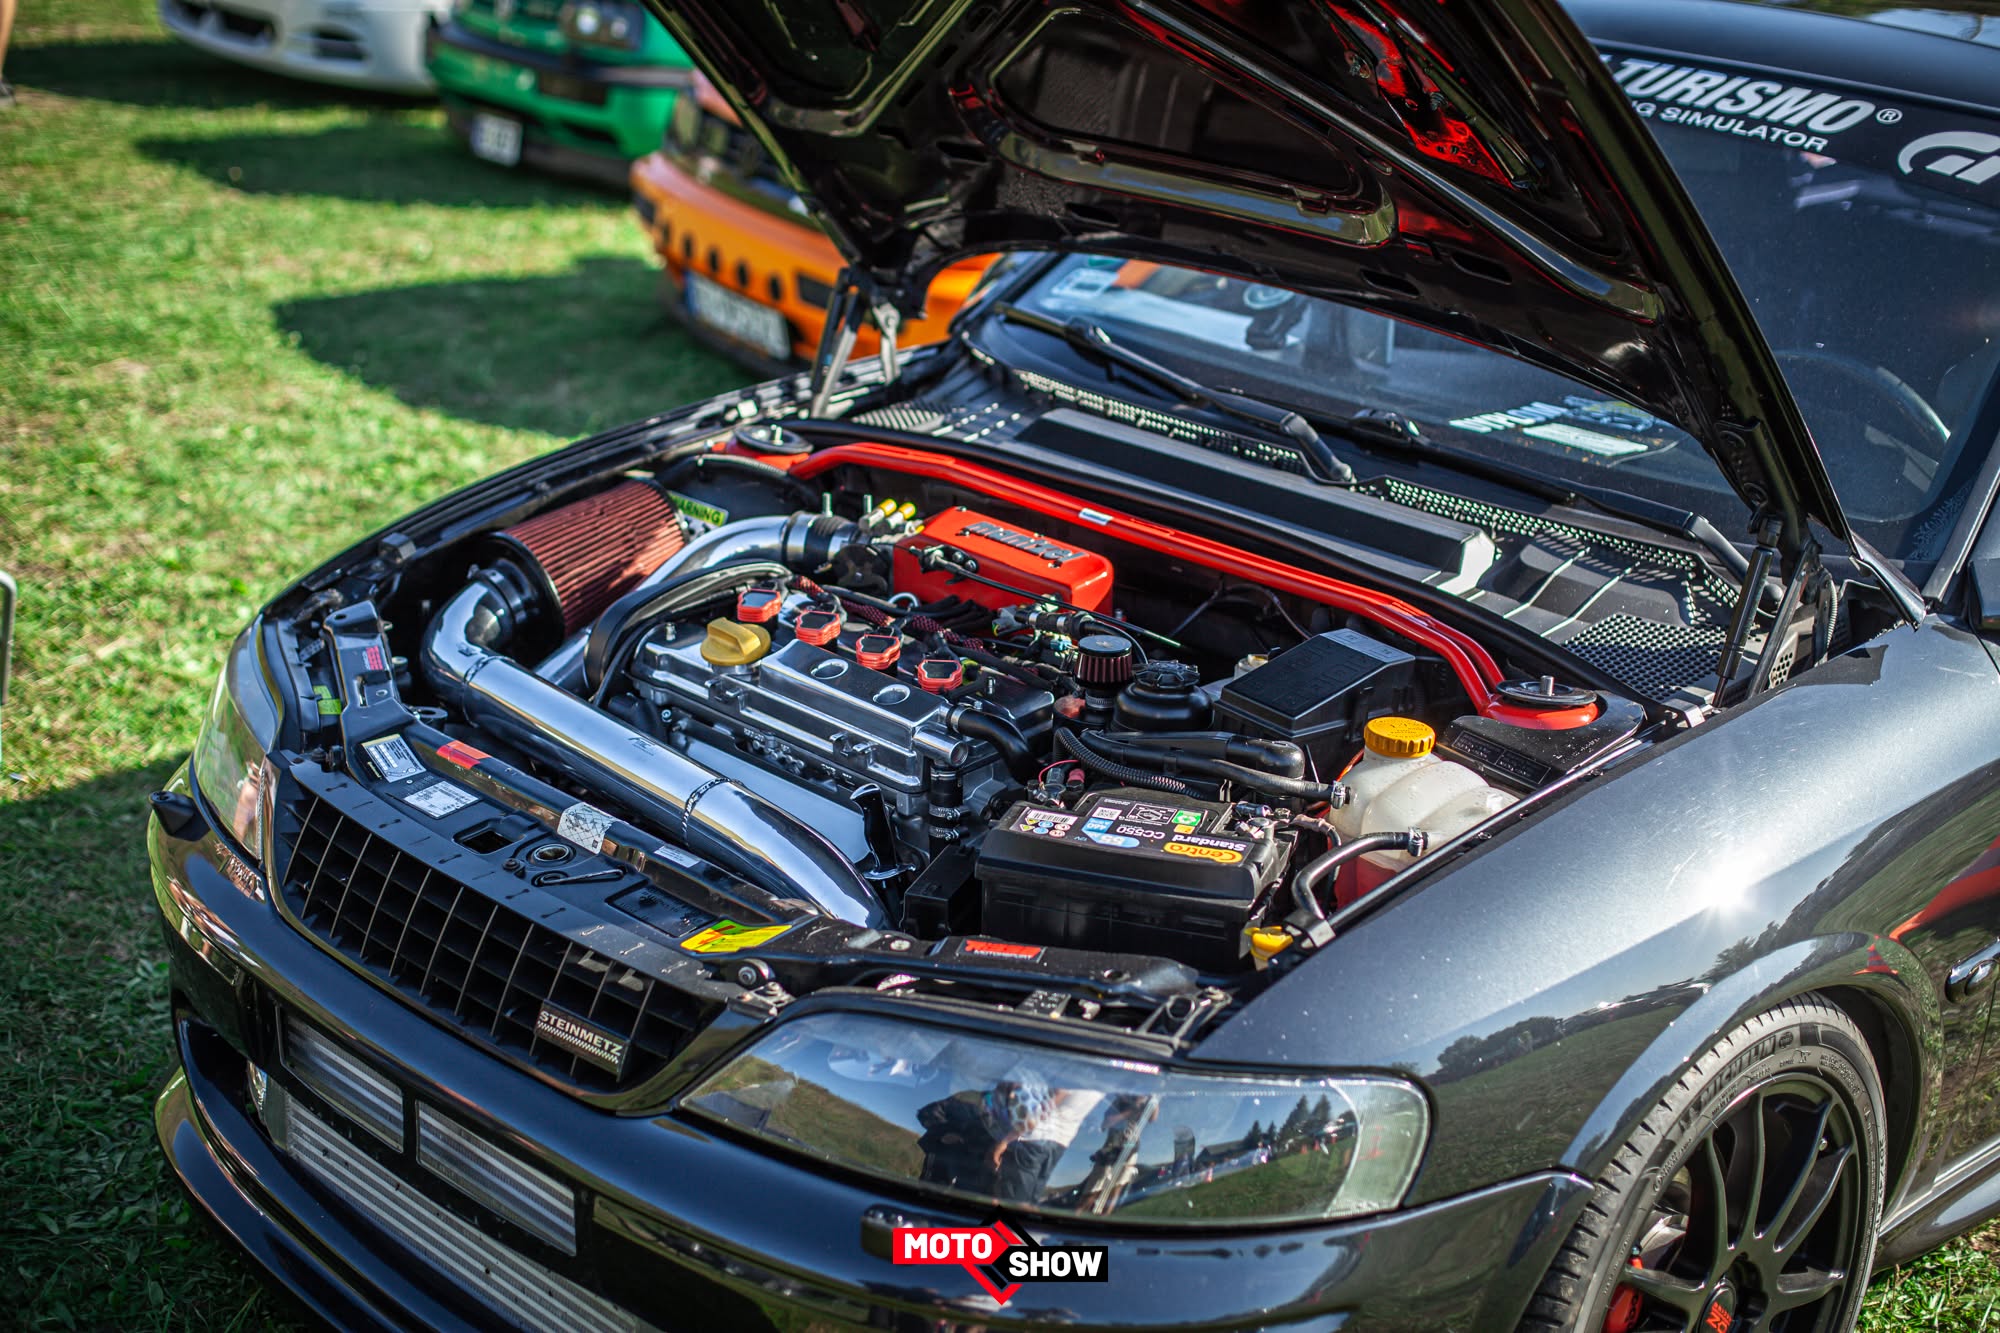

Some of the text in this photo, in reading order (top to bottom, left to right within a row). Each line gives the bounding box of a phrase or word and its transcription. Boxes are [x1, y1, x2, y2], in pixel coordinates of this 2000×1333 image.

[1660, 106, 1829, 152] SIMULATOR
[1116, 825, 1166, 840] CC550
[1171, 834, 1248, 852] Standard
[1169, 843, 1237, 861] Centro
[538, 1010, 624, 1057] STEINMETZ
[1699, 1033, 1777, 1109] MICHELIN
